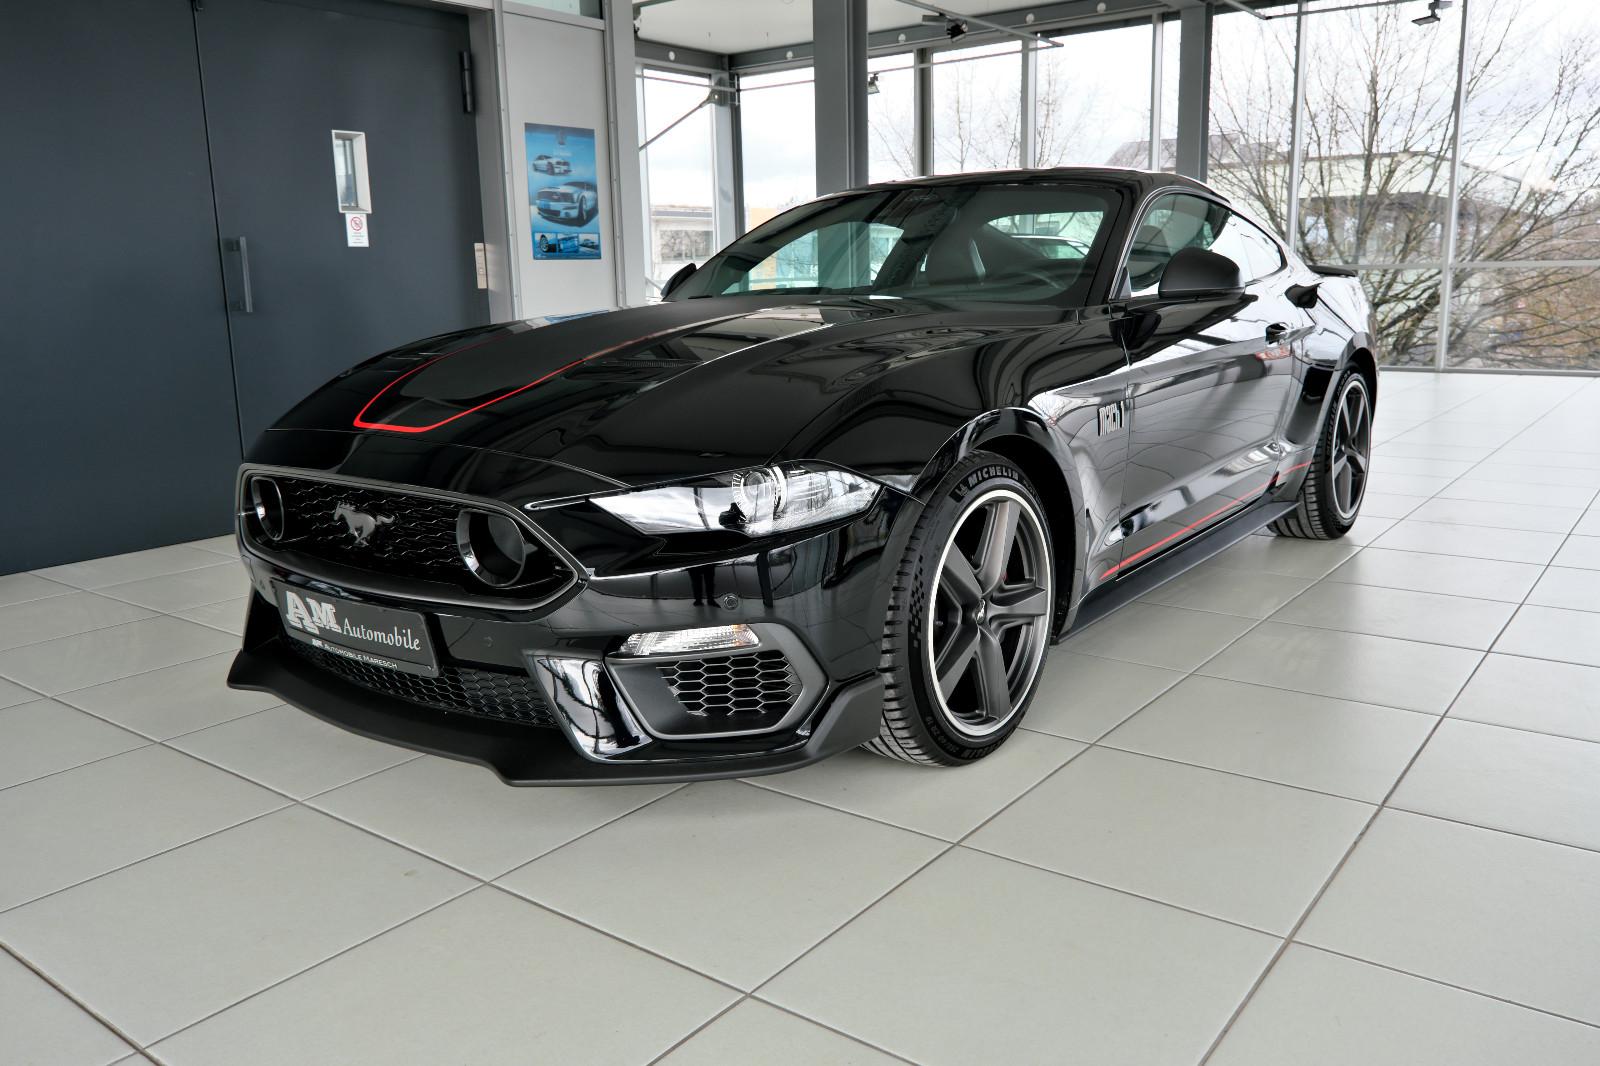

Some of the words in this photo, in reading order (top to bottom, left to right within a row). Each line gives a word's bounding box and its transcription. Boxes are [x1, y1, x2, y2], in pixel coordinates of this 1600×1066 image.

[968, 466, 1019, 487] MICHELIN
[285, 591, 342, 635] AM
[343, 617, 421, 651] Automobile
[324, 643, 362, 661] AUTOMOBILE
[363, 655, 398, 670] MARESCH
